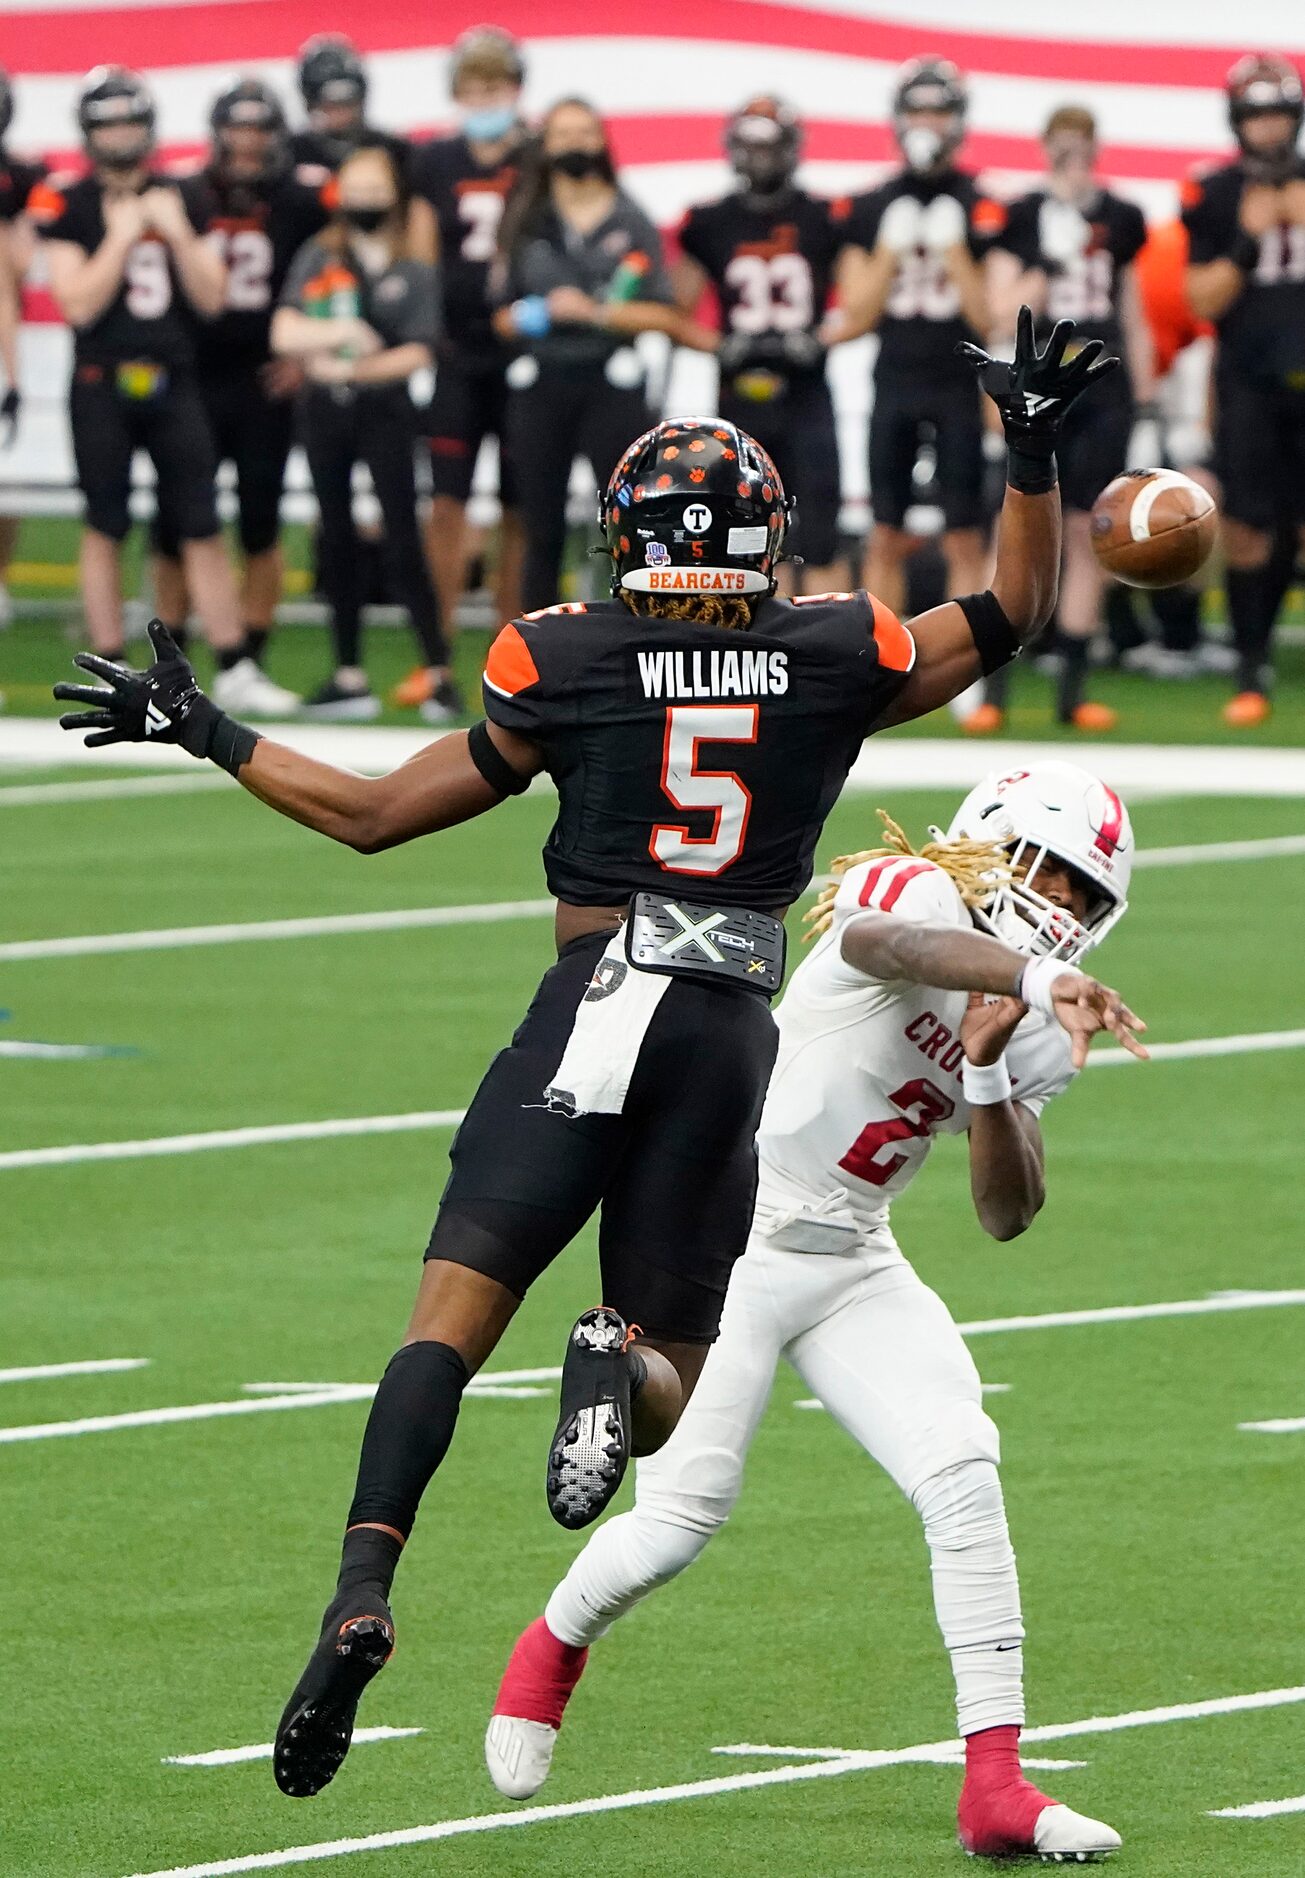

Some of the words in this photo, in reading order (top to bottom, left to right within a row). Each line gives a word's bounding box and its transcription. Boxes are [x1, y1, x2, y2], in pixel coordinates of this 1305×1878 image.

[726, 253, 814, 331] 33
[688, 508, 707, 530] T
[691, 541, 704, 558] 5
[649, 572, 746, 590] BEARCATS
[637, 650, 789, 698] WILLIAMS
[649, 704, 759, 876] 5
[838, 1078, 955, 1186] 2
